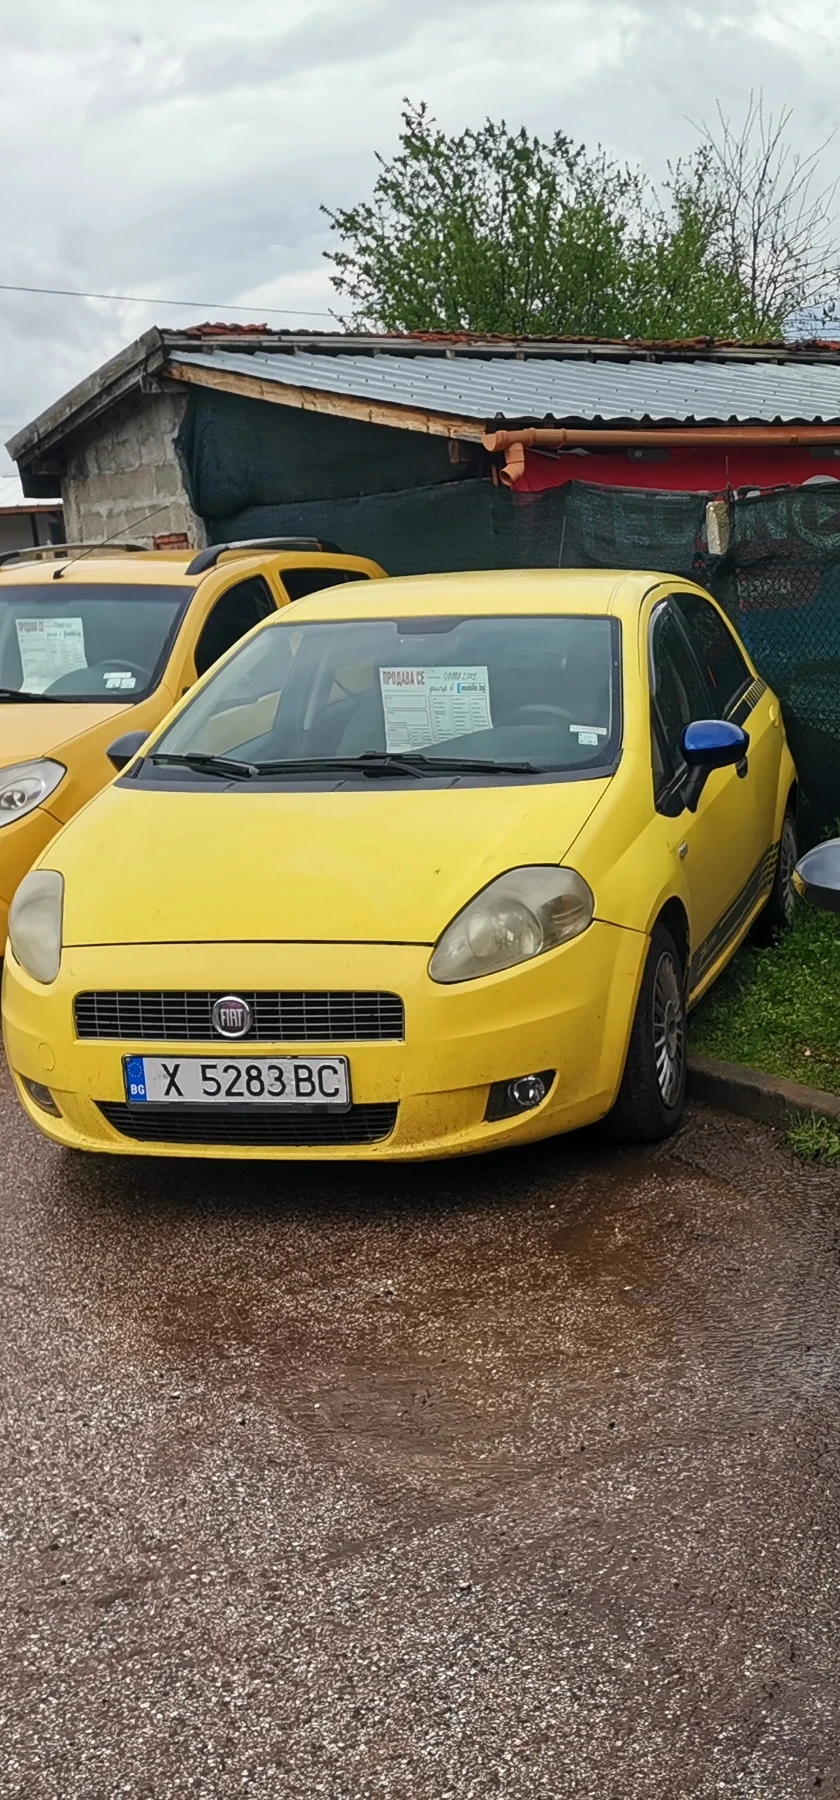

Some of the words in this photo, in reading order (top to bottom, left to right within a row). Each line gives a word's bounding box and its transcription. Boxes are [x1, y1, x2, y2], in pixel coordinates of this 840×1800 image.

[382, 671, 414, 687] ПРОДАВА
[416, 671, 426, 685] СЕ
[220, 1008, 243, 1027] FIAT
[161, 1063, 184, 1097] X
[130, 1084, 145, 1095] BG
